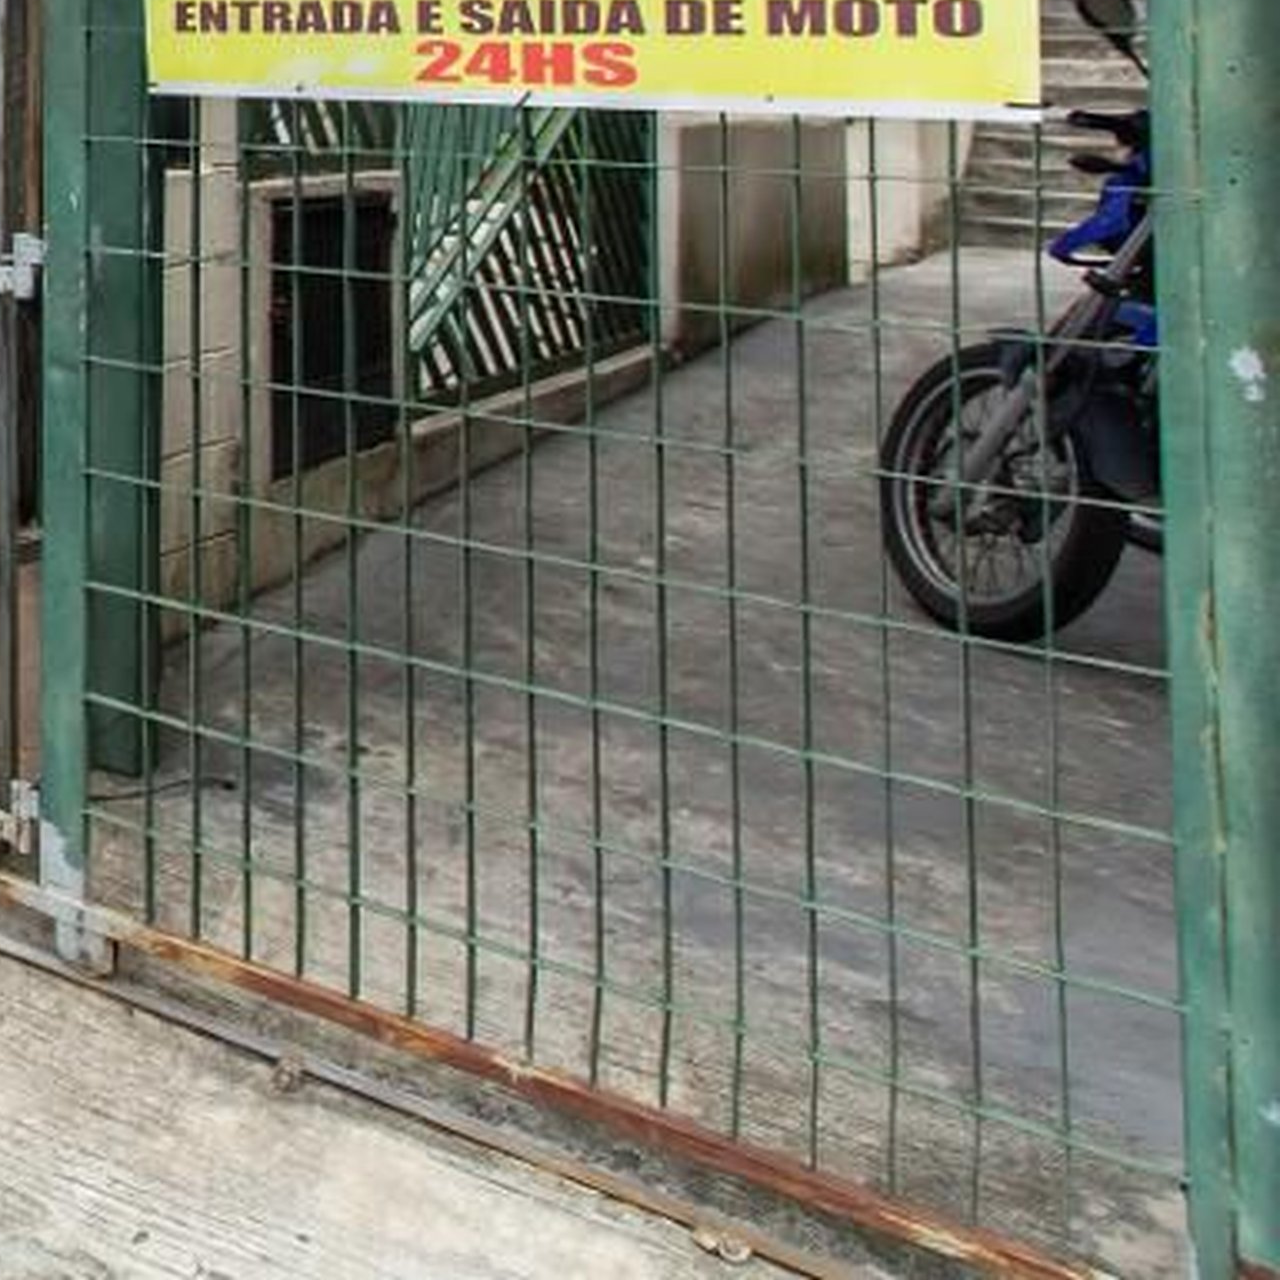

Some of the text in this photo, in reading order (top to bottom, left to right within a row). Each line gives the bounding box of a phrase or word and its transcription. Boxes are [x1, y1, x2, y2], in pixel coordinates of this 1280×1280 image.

[174, 0, 400, 34] ENTRADA
[416, 0, 444, 34] E
[414, 40, 639, 87] 24HS
